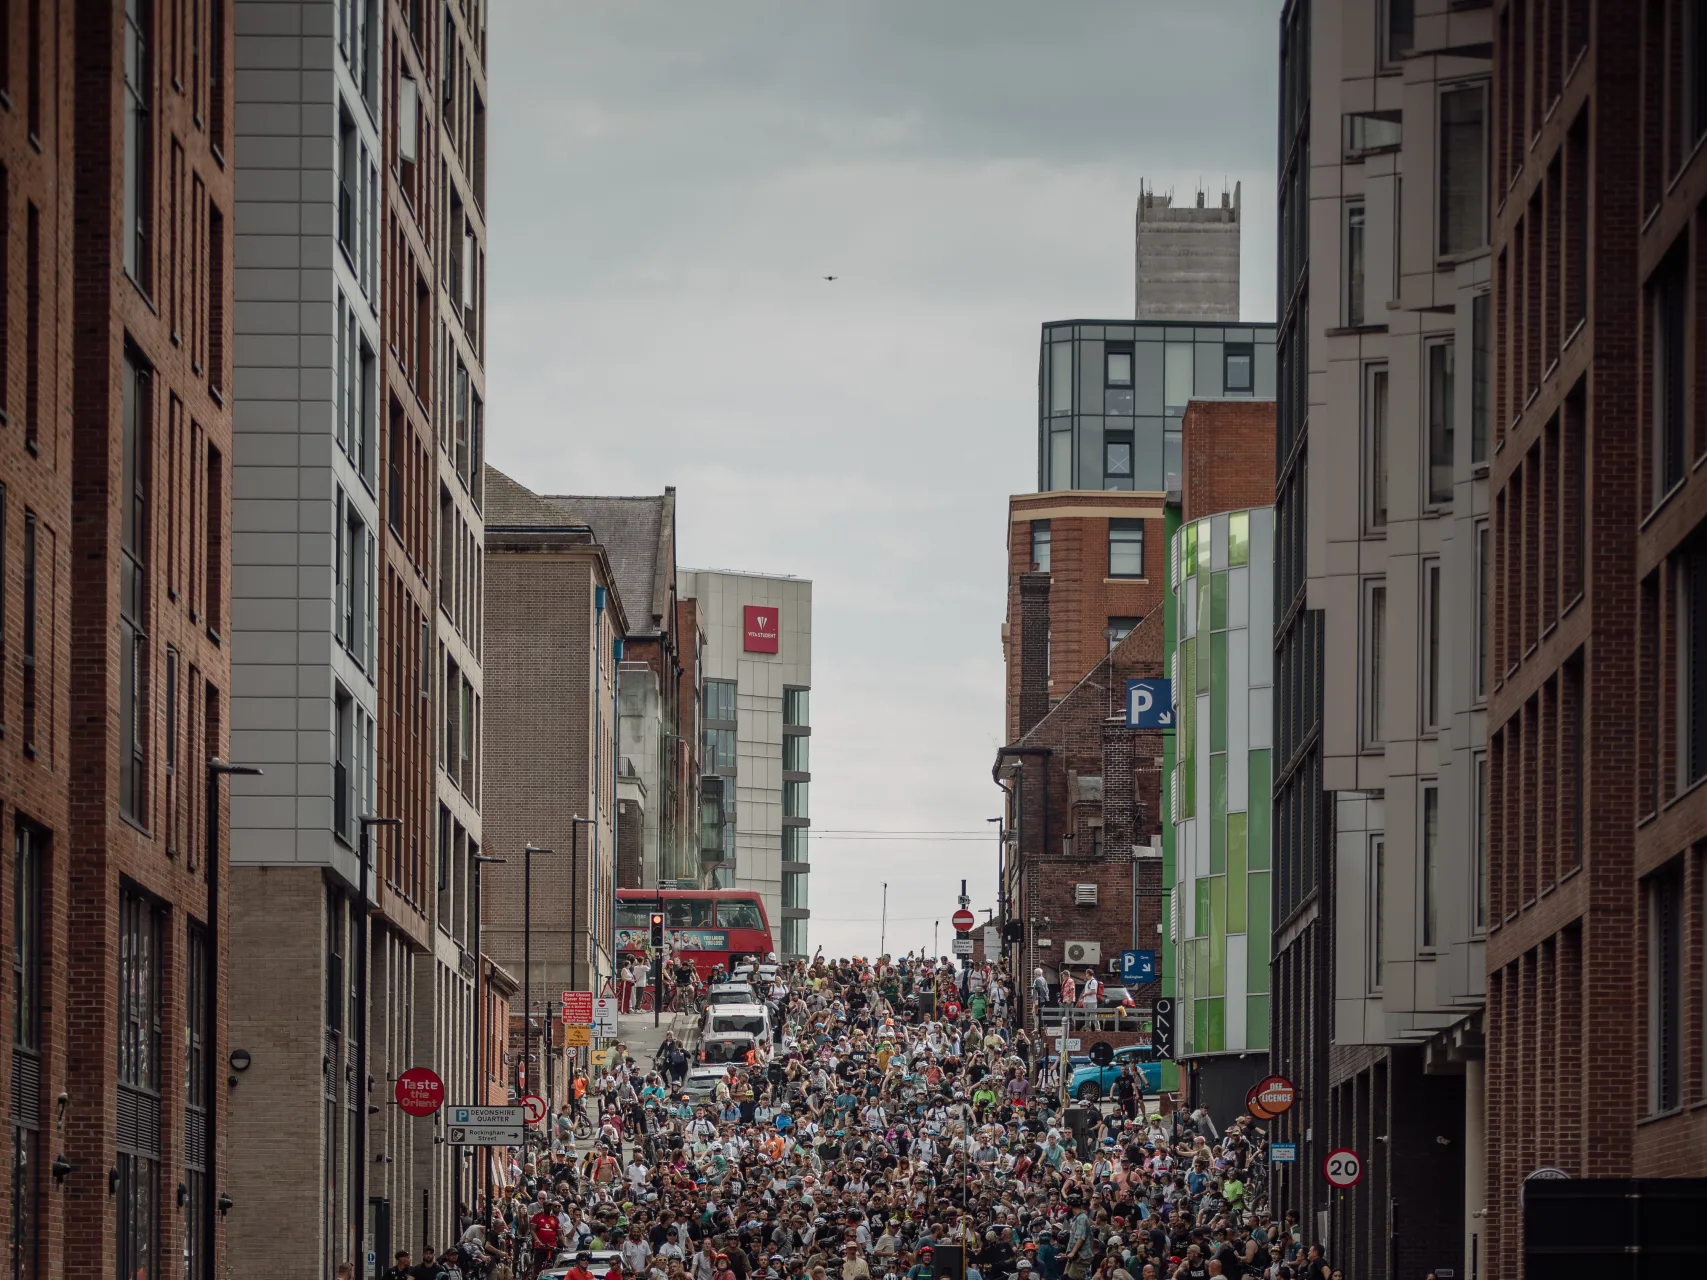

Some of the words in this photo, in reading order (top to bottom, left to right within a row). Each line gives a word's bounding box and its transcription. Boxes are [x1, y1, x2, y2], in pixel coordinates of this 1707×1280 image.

[1131, 690, 1153, 724] P
[1124, 955, 1135, 972] P
[1156, 1000, 1171, 1058] ONYX
[401, 1079, 438, 1090] Taste
[1269, 1082, 1283, 1091] OFF
[410, 1090, 430, 1099] the
[1261, 1093, 1292, 1103] LICENCE
[401, 1097, 437, 1108] Orient
[458, 1111, 468, 1121] P
[469, 1129, 506, 1137] Rockingham
[1330, 1160, 1358, 1176] 20
